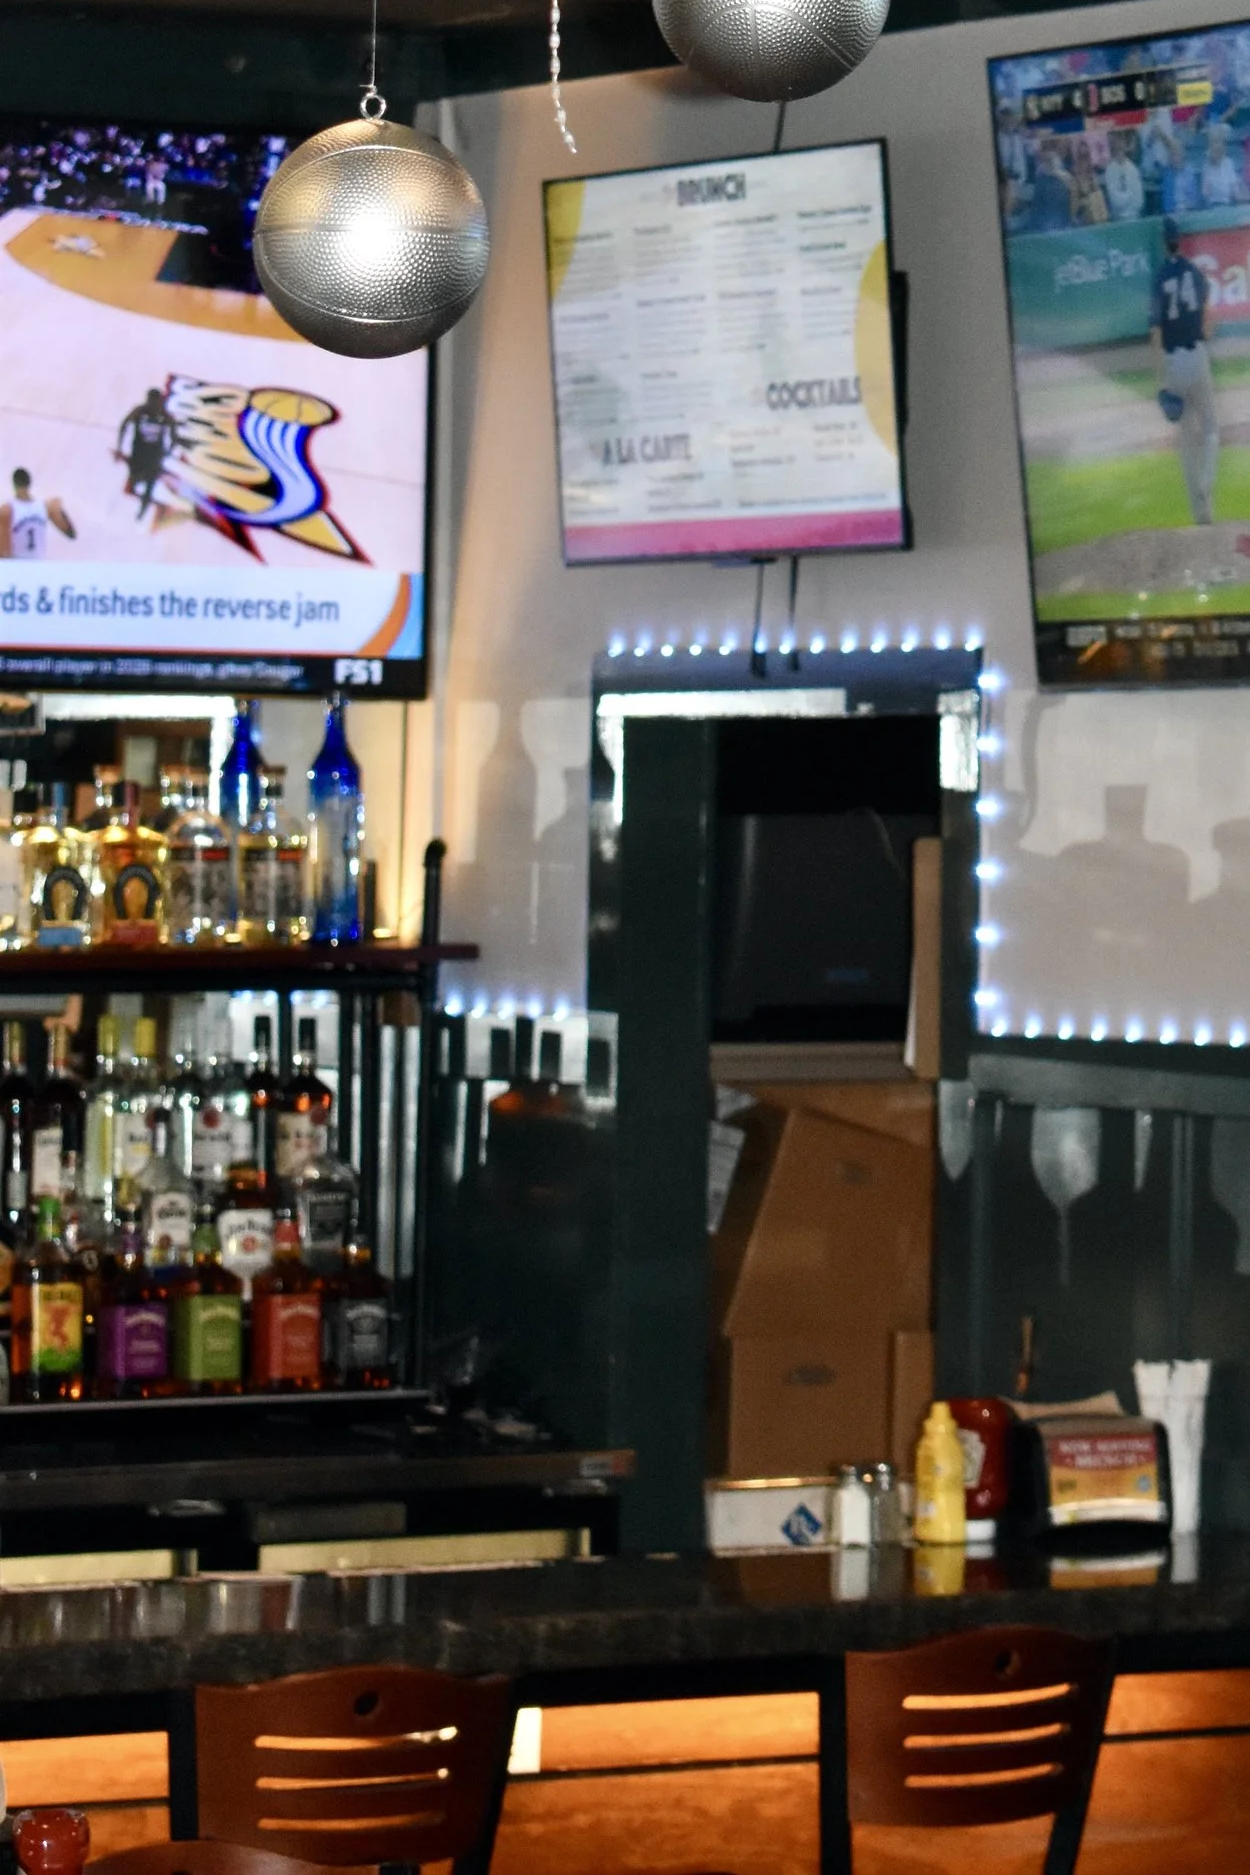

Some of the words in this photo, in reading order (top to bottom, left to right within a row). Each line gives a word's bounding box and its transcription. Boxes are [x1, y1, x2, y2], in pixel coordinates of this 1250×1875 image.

[677, 173, 746, 207] BRUNCH
[1162, 270, 1199, 320] 74
[766, 377, 861, 411] COCKTAILS
[36, 585, 54, 614] &
[59, 584, 153, 617] finishes
[160, 589, 197, 618] the
[203, 596, 291, 620] reverse
[294, 591, 340, 628] jam
[334, 658, 383, 685] FS1
